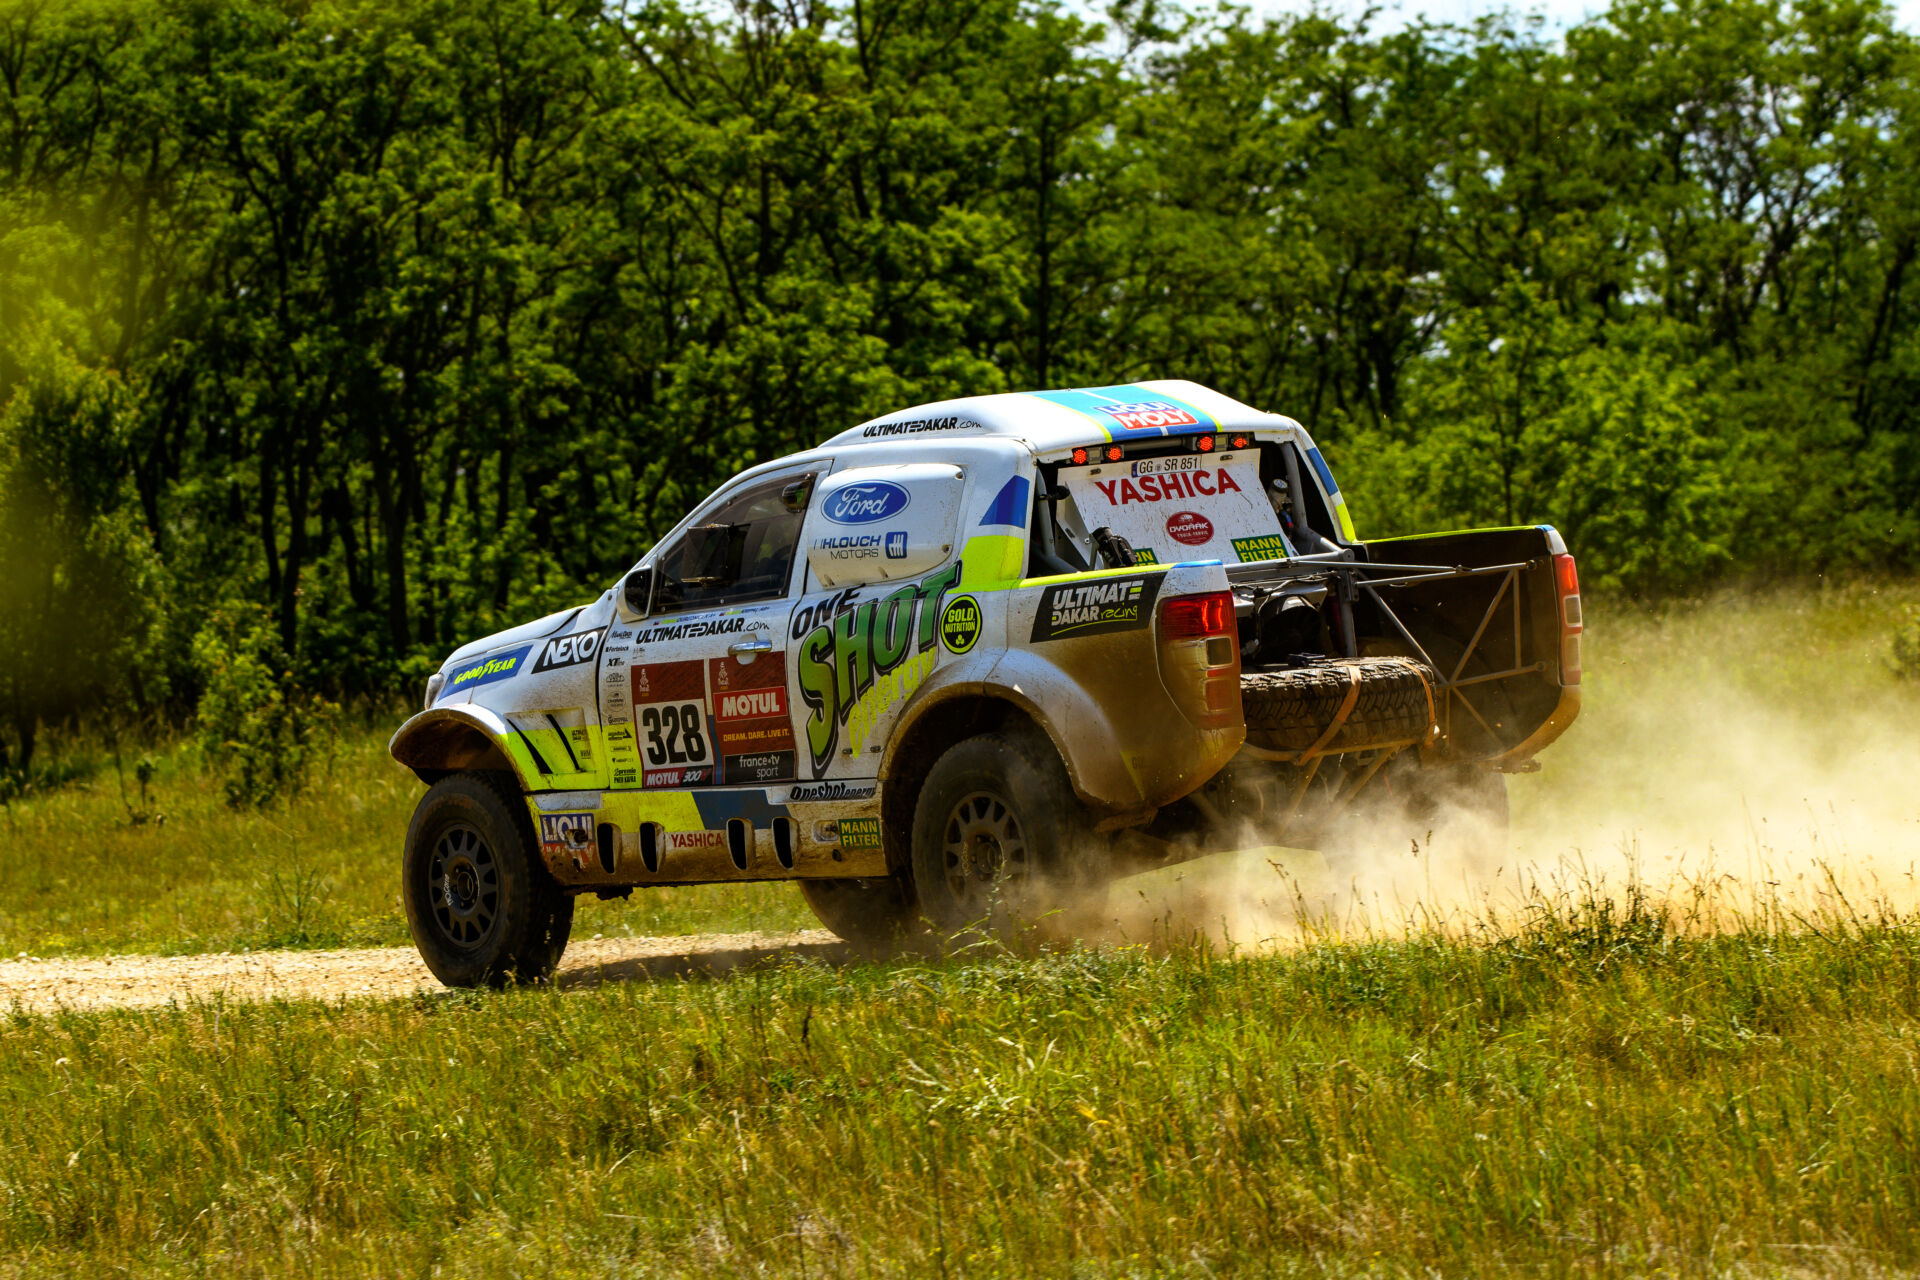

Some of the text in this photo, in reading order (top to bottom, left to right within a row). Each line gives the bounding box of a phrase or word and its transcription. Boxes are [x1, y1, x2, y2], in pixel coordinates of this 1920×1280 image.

[1099, 401, 1178, 414] LIQUI
[1113, 409, 1190, 428] MOLY
[1139, 457, 1198, 474] GG SR 851
[1095, 468, 1242, 506] YASHICA
[835, 487, 891, 518] Ford
[822, 535, 882, 549] HLOUCH
[1235, 536, 1282, 552] MANN
[830, 548, 879, 560] MOTORS
[1241, 548, 1287, 563] FILTER
[1053, 580, 1144, 609] ULTIMATE
[792, 583, 867, 640] ONE
[1051, 602, 1139, 626] DAKAR racing
[944, 621, 976, 634] NUTRITION
[542, 631, 599, 667] NEXO
[798, 560, 962, 781] SHOT
[722, 692, 780, 717] MOTUL
[849, 645, 937, 760] energy
[643, 704, 706, 765] 328
[723, 728, 790, 742] DREAM. DARE. LIVE IT.
[646, 771, 680, 786] MOTUL
[756, 767, 779, 780] sport
[840, 820, 878, 834] MANN
[671, 832, 725, 848] YASHICA
[842, 833, 880, 847] FILTER
